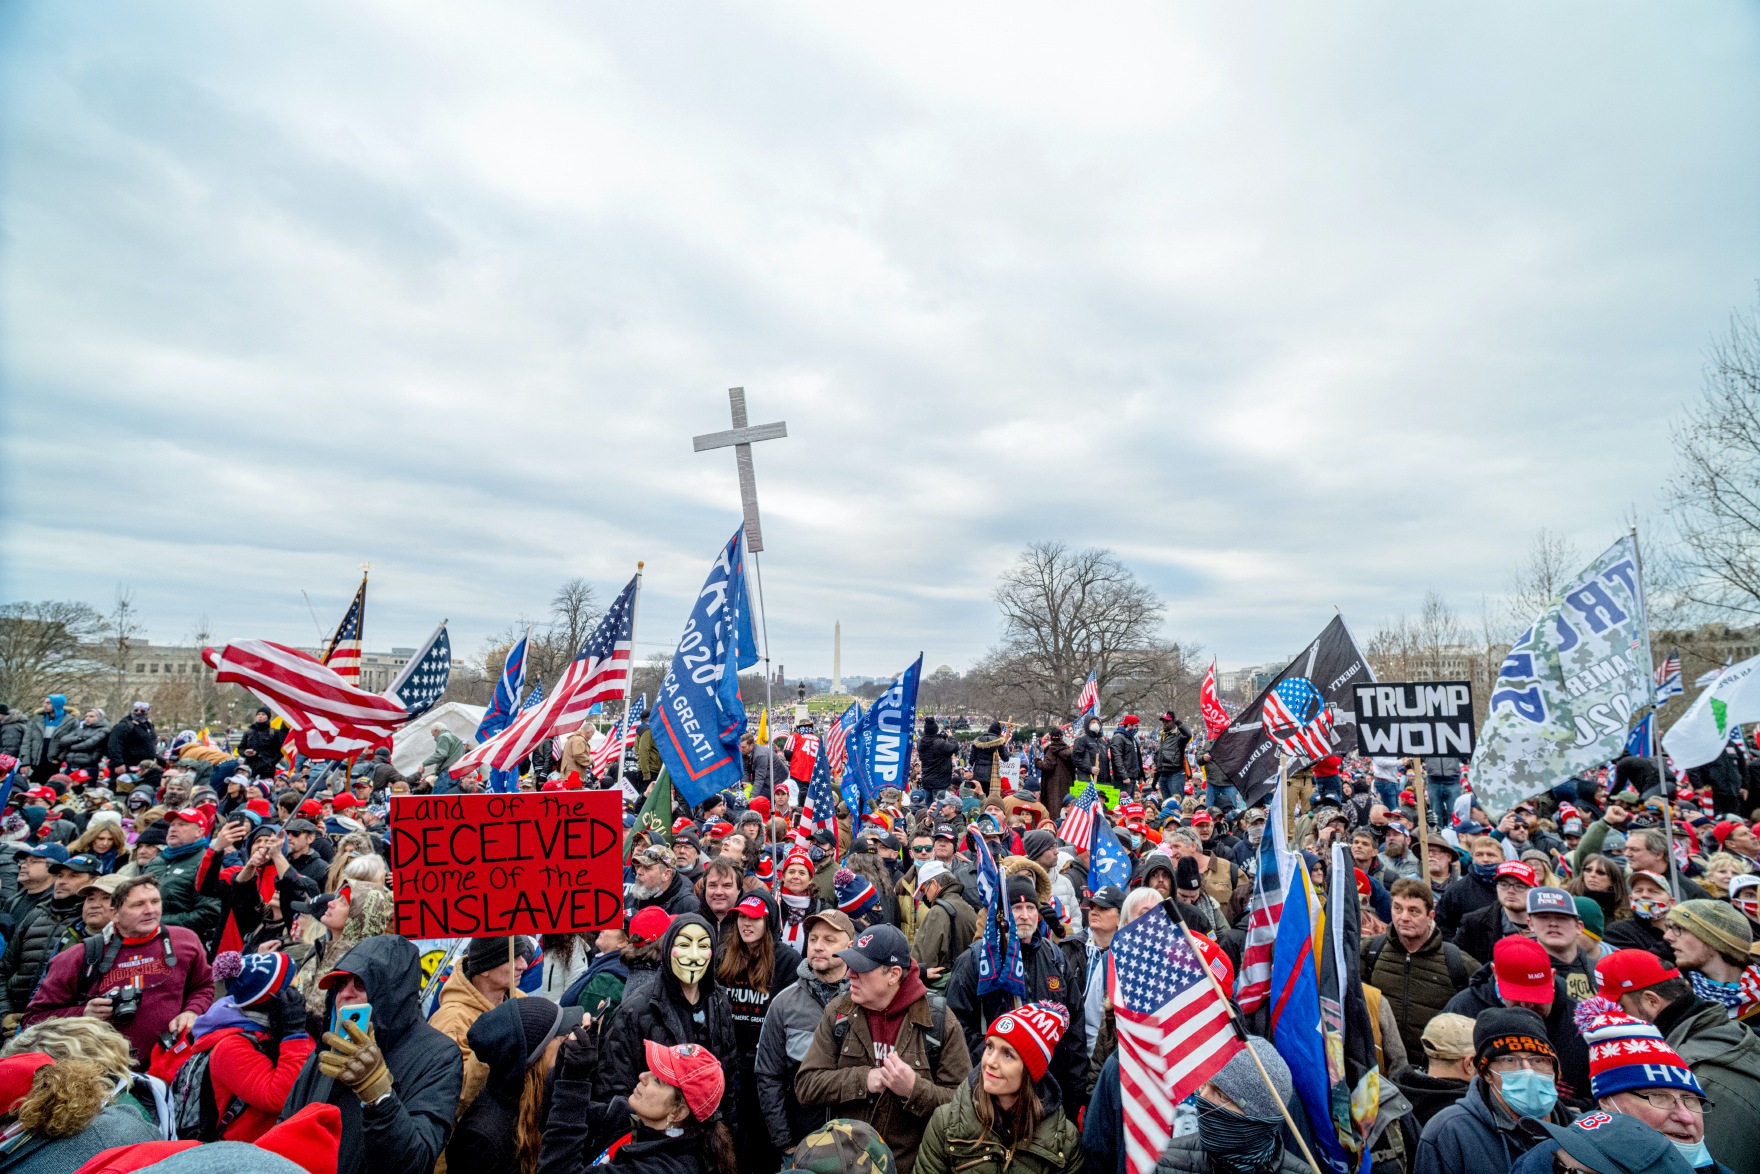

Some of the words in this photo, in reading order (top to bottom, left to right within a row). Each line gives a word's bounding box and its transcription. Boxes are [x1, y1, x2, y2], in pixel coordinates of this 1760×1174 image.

[1356, 685, 1470, 717] TRUMP
[673, 696, 716, 762] GREAT!
[1359, 722, 1472, 755] WON
[801, 739, 820, 757] 45
[394, 795, 464, 822] Land
[392, 817, 618, 869] DECEIVED
[1537, 892, 1563, 900] TRUMP
[394, 888, 621, 939] ENSLAVED
[118, 960, 141, 968] VIRGINIA
[1527, 972, 1545, 980] MAGA
[726, 987, 770, 1005] TRUMP
[999, 1020, 1011, 1031] 45
